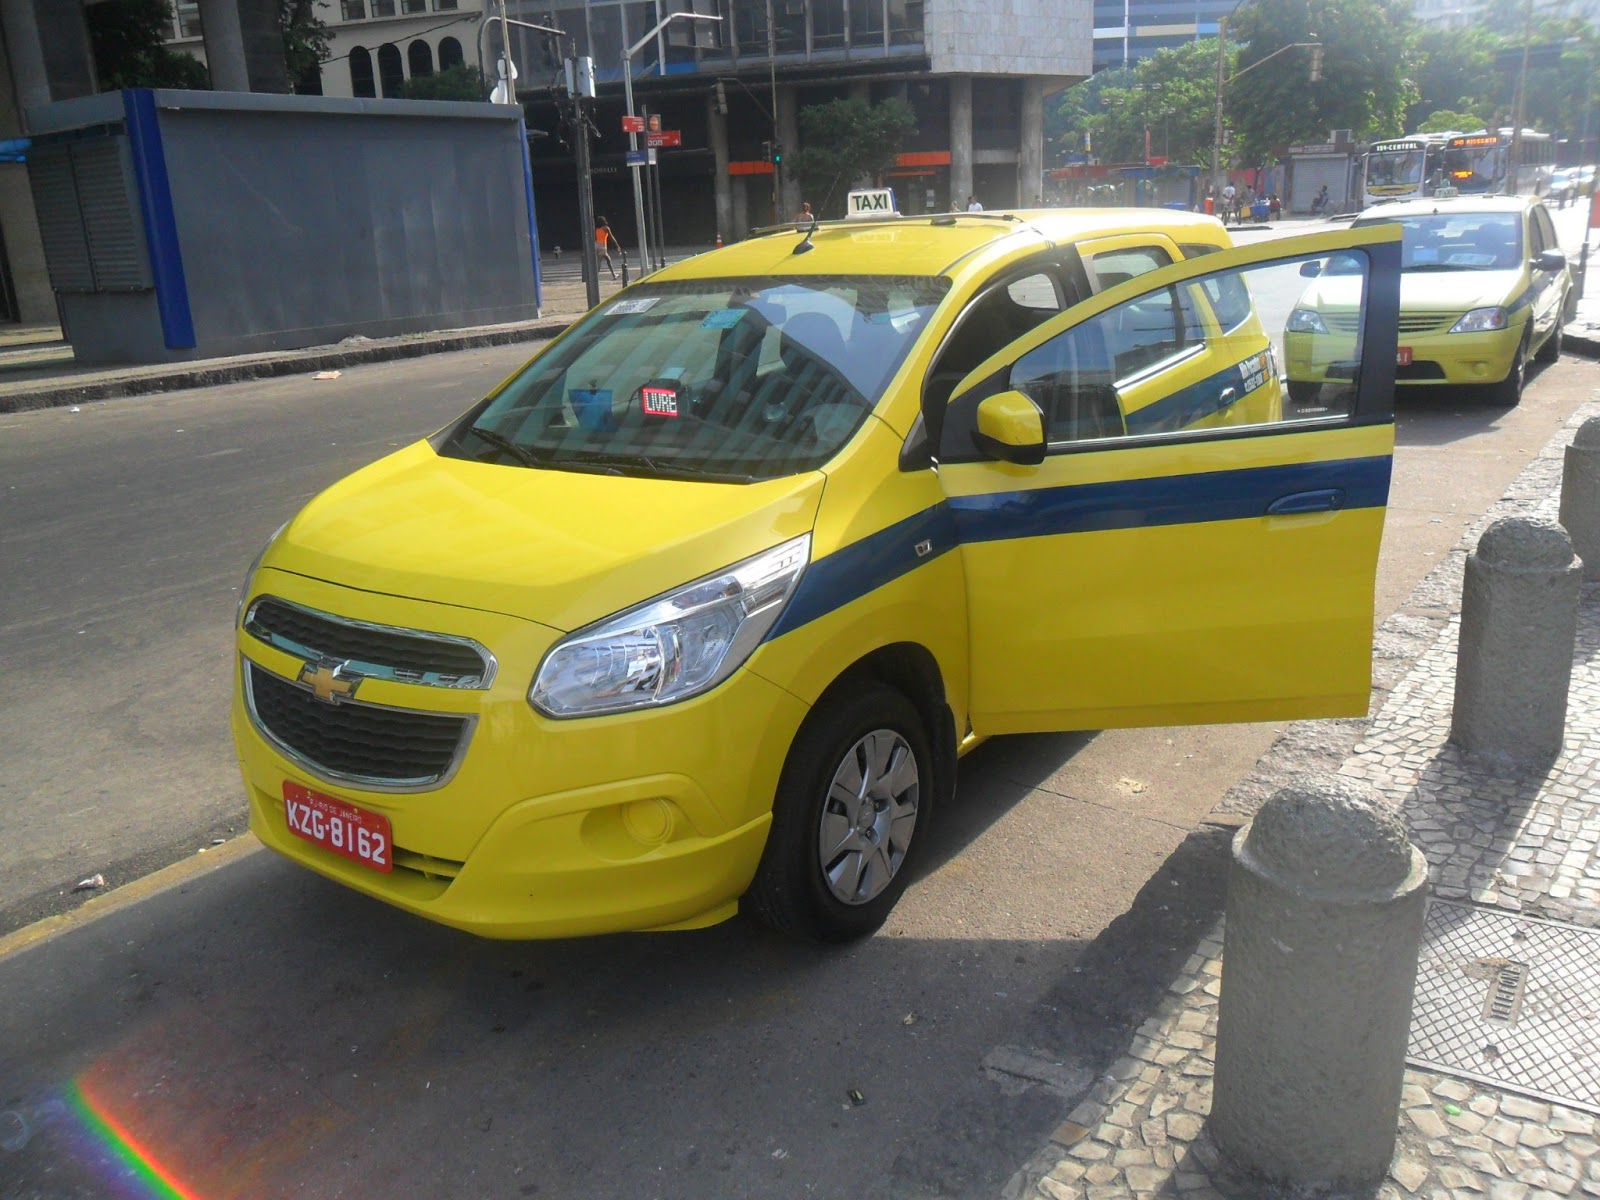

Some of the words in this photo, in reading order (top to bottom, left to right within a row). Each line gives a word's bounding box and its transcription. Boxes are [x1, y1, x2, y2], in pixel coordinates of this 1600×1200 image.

[852, 194, 888, 211] TAXI
[645, 391, 677, 413] LIVRE
[339, 809, 362, 825] JANEIRO
[1490, 966, 1521, 1020] TELEFONE
